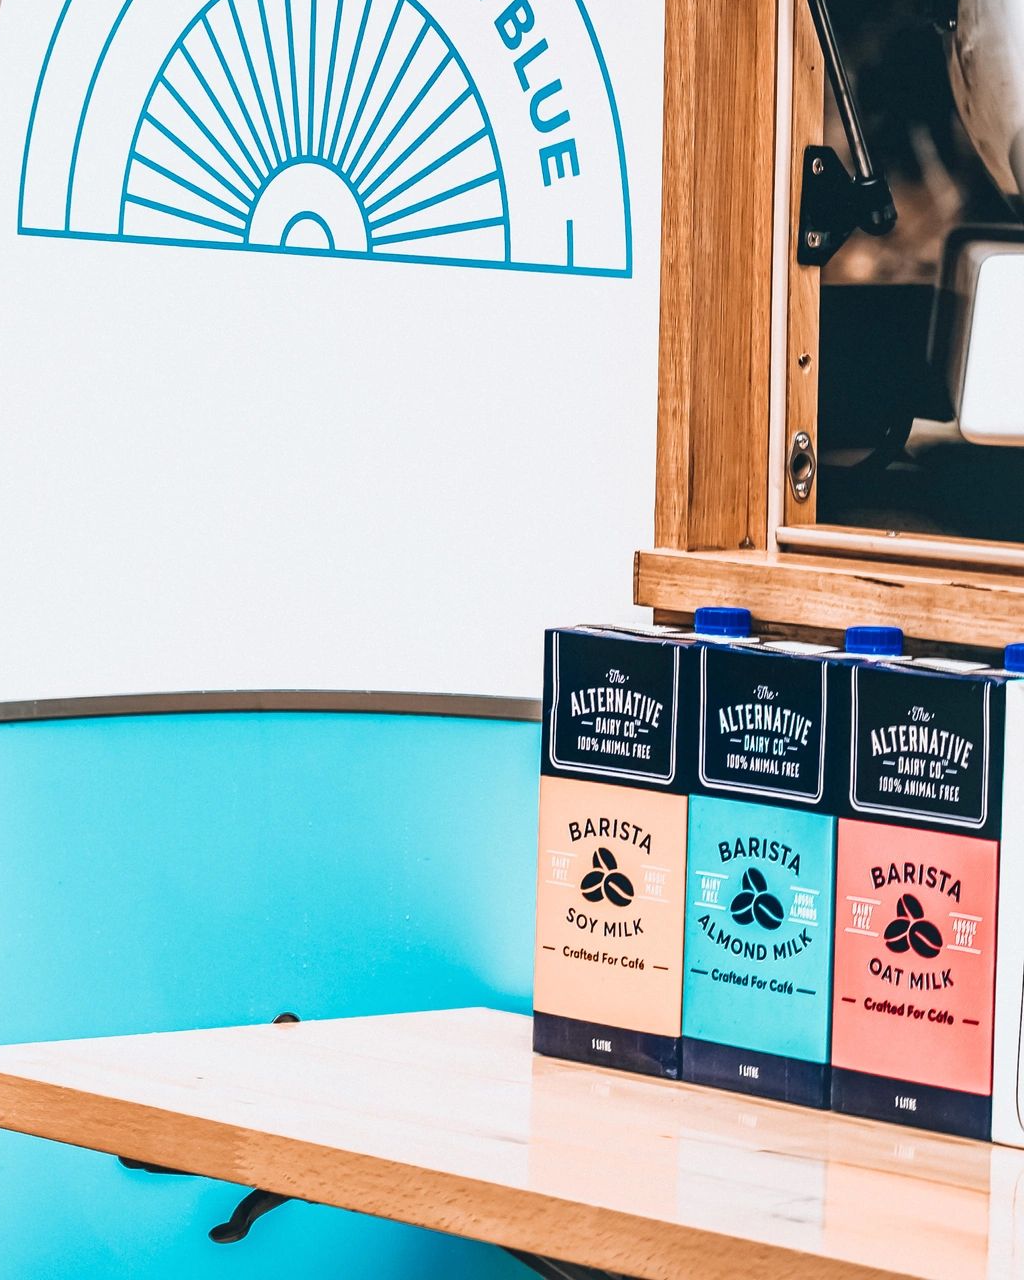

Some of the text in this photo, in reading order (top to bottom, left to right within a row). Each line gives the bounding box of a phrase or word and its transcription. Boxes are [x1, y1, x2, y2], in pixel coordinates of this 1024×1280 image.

[609, 669, 626, 683] The
[757, 685, 774, 700] The
[570, 687, 663, 728] ALTERNATIVE
[912, 705, 930, 722] The
[595, 716, 621, 736] DAIRY
[719, 703, 812, 746] ALTERNATIVE
[577, 736, 651, 760] 100% ANIMAL FREE
[744, 734, 770, 753] DAIRY
[870, 725, 974, 769] ALTERNATIVE
[727, 753, 800, 778] 100% ANIMAL FREE
[898, 756, 926, 777] DAIRY
[879, 776, 960, 802] 100% ANIMAL FREE
[568, 817, 652, 855] BARISTA
[718, 836, 801, 876] BARISTA
[870, 862, 961, 903] BARISTA
[566, 907, 644, 938] SOY MILK
[697, 914, 812, 961] ALMOND MILK
[563, 945, 600, 963] Crafted
[602, 953, 618, 966] For
[711, 968, 749, 987] Crafted
[751, 975, 767, 990] For
[869, 957, 954, 991] OAT MILK
[864, 997, 905, 1017] Crafted
[907, 1005, 925, 1020] For
